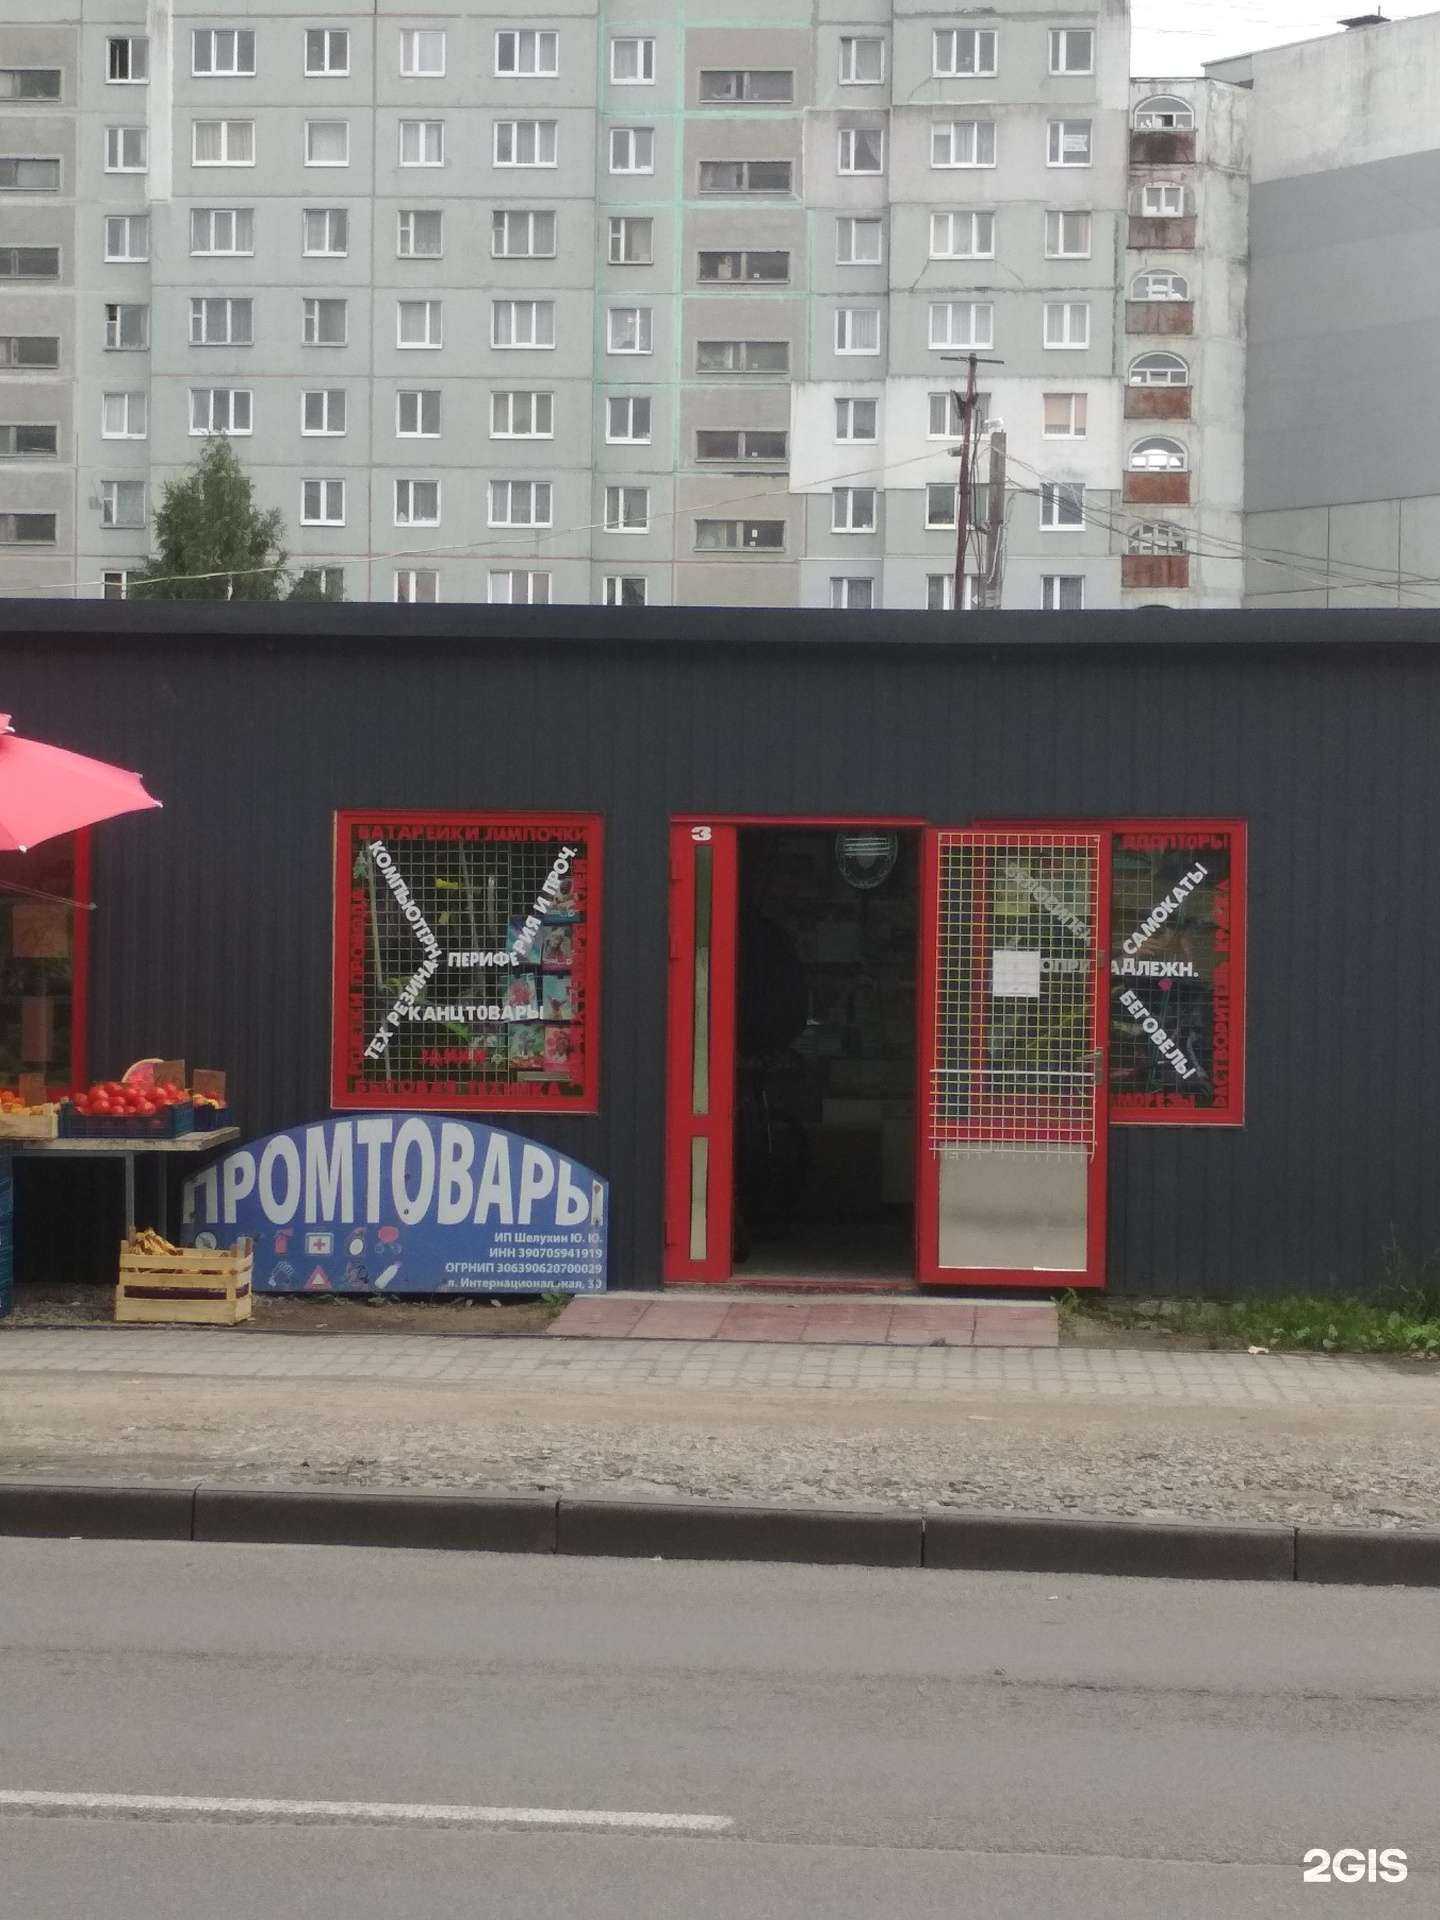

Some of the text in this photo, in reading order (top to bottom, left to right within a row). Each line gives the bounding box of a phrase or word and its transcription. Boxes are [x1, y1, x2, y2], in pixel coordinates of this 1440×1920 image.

[691, 825, 712, 841] 3
[1123, 862, 1208, 954] САМОКАТЫ
[363, 960, 439, 1059] ТЕХ РЕЗИНА
[408, 1004, 544, 1022] КАНЦТОВАРЫ
[1120, 990, 1196, 1079] БЕГОВЕЛЫ
[183, 1118, 603, 1226] ПРОМТОВАРЫ
[495, 1232, 511, 1243] ИП
[489, 1248, 603, 1258] ИНН 390705941919
[445, 1262, 494, 1273] ОГРНИП
